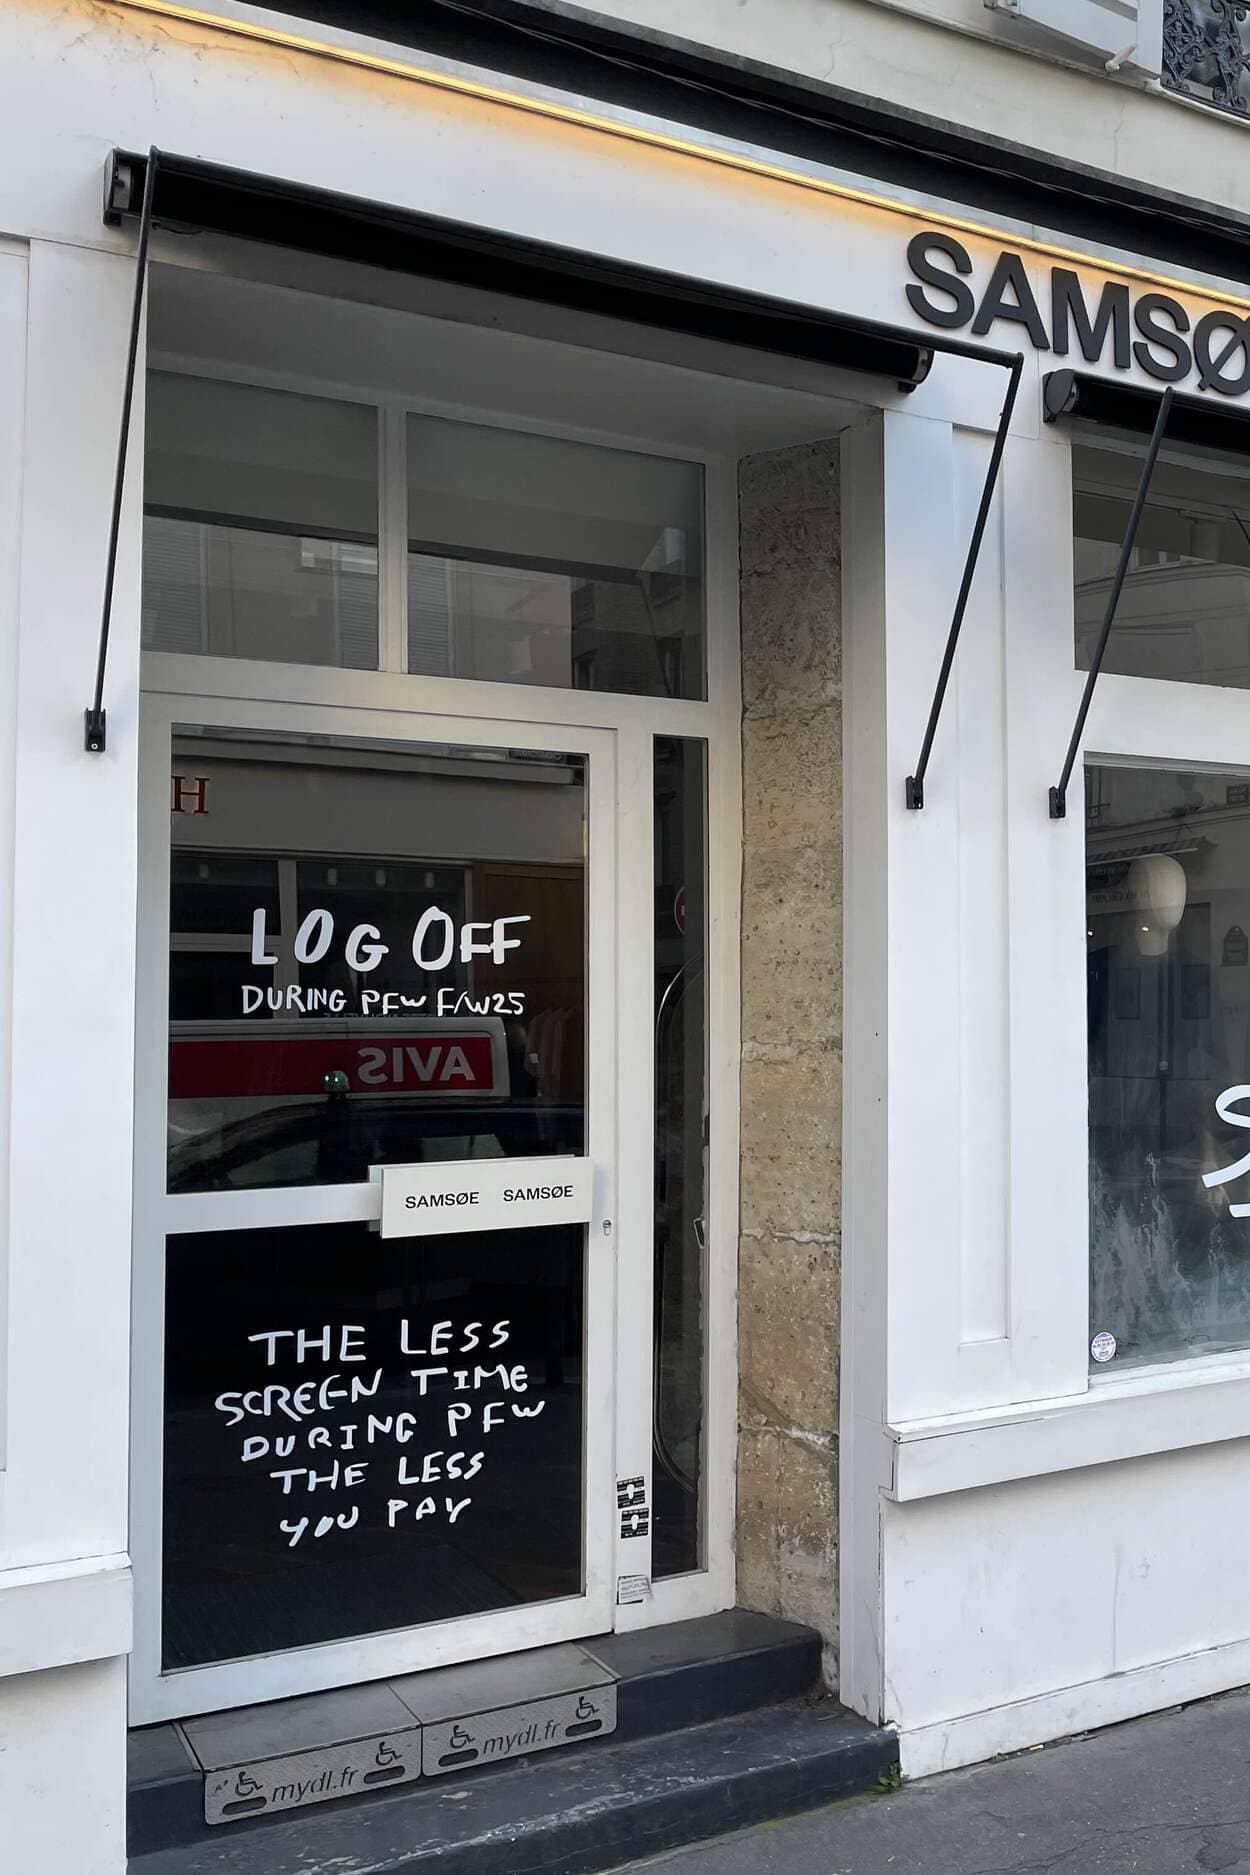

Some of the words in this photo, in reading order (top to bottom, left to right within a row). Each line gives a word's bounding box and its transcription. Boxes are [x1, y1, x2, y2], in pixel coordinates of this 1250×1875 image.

[252, 908, 389, 972] LOG
[412, 905, 531, 971] OFF
[241, 984, 347, 1015] DURING
[361, 989, 427, 1015] PFW
[405, 1191, 480, 1210] SAMSØE
[502, 1185, 574, 1203] SAMSØE
[247, 1325, 366, 1366] THE
[400, 1319, 510, 1355] LESS
[214, 1367, 383, 1427] SCREEN
[410, 1364, 528, 1395] TIME
[241, 1412, 417, 1462] DURING
[447, 1400, 545, 1437] PFW
[269, 1459, 369, 1494] THE
[398, 1451, 485, 1485] LESS
[387, 1496, 472, 1528] PAY
[482, 1720, 562, 1755] mydl.fr
[272, 1767, 359, 1803] mydl.fr
